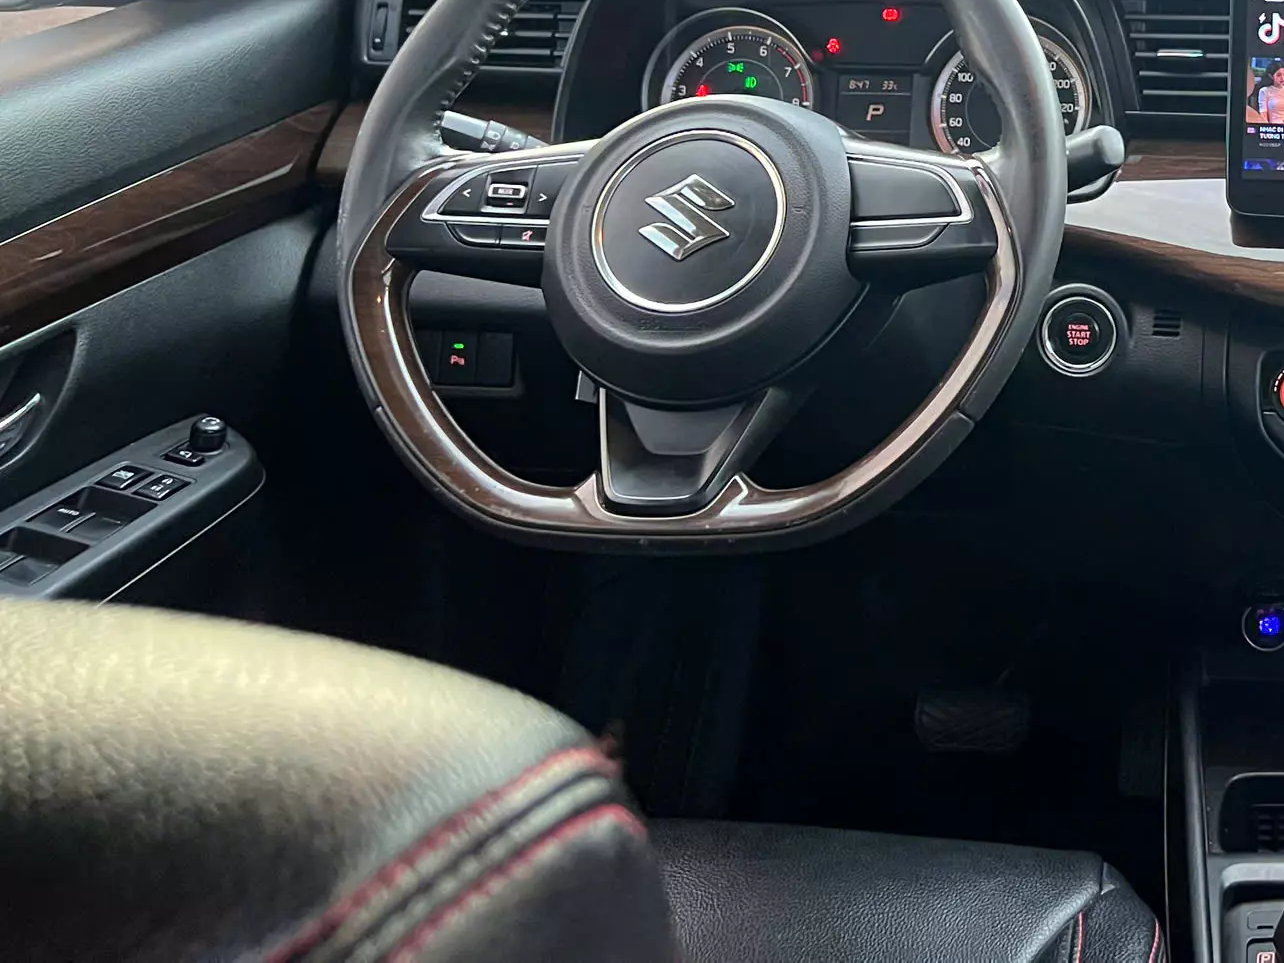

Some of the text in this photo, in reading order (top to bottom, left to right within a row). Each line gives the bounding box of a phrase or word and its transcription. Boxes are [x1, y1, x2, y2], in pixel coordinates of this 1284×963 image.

[727, 42, 735, 54] 5
[759, 45, 768, 57] 6
[696, 57, 704, 68] 4
[784, 66, 792, 78] 7
[957, 72, 974, 83] 100
[678, 85, 687, 96] 3
[950, 93, 963, 103] 80
[866, 104, 884, 121] P
[949, 117, 963, 127] 60
[957, 137, 971, 147] 40
[1066, 330, 1091, 338] START
[1068, 338, 1089, 346] STOP
